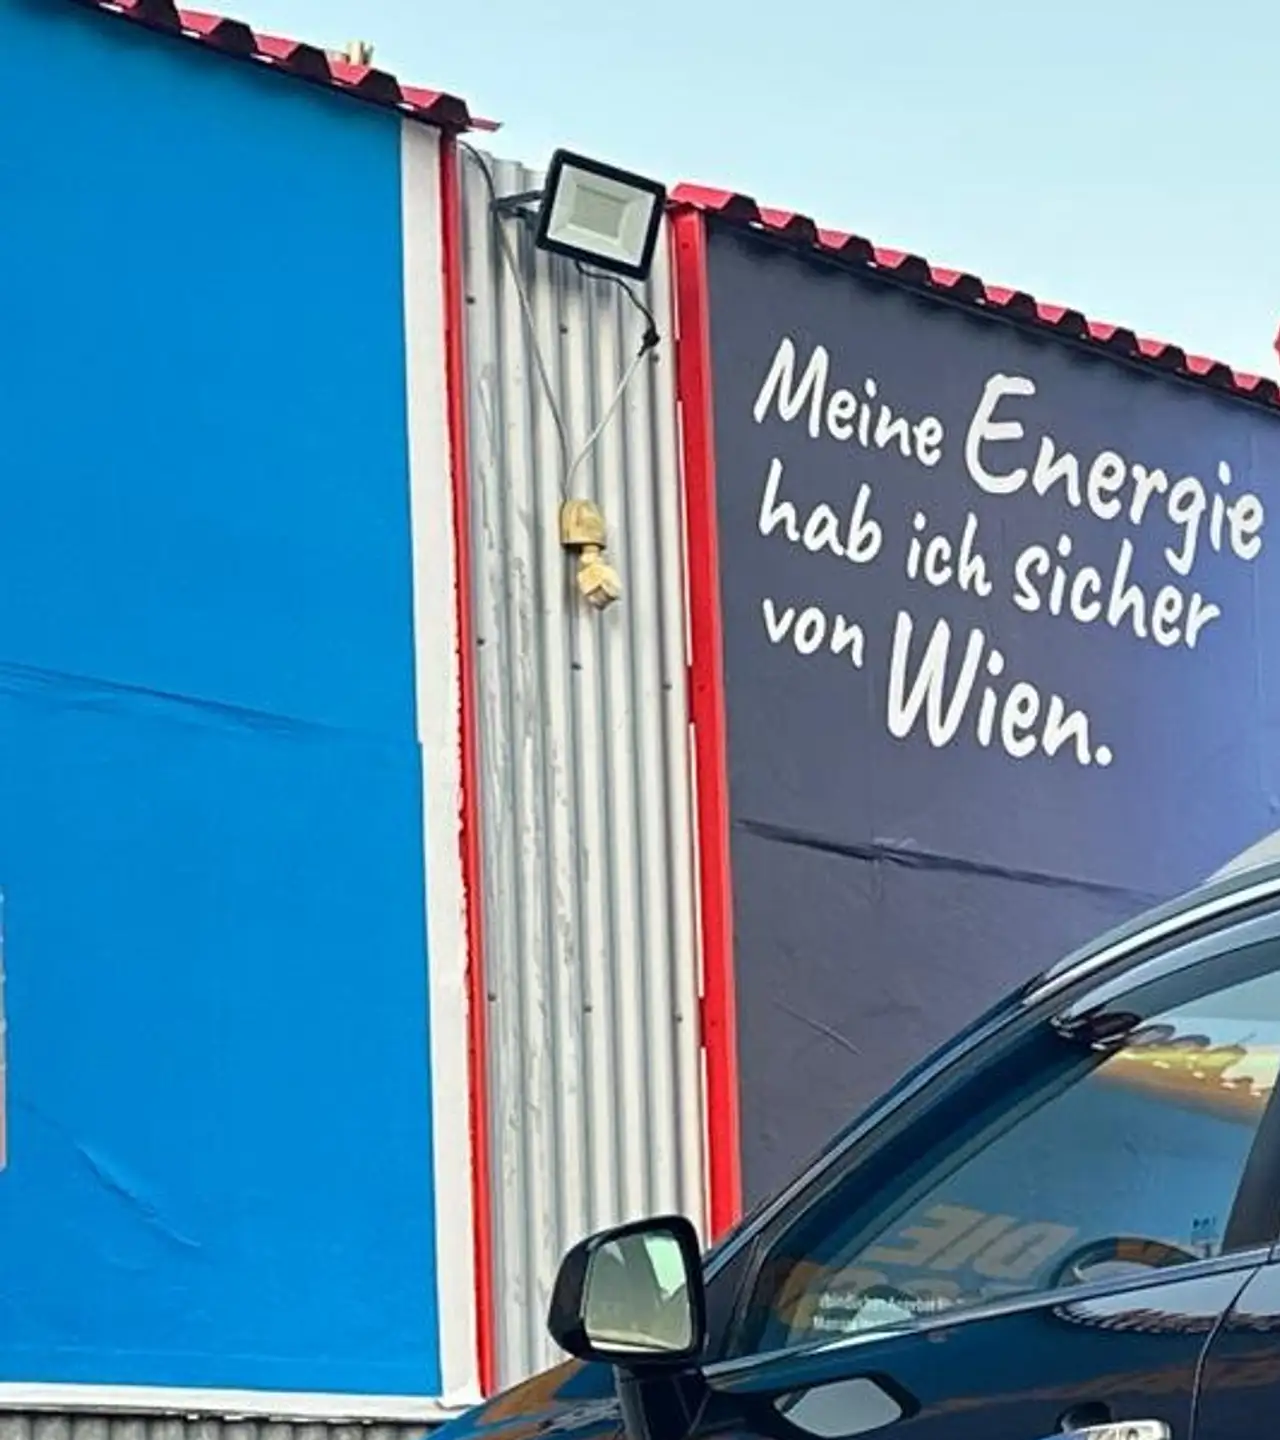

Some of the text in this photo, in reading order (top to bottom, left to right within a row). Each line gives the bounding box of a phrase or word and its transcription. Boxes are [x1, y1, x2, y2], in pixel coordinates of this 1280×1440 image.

[752, 337, 1264, 577] Meine Energie
[758, 457, 1222, 649] hab ich sicher
[762, 597, 1114, 767] von Wien.
